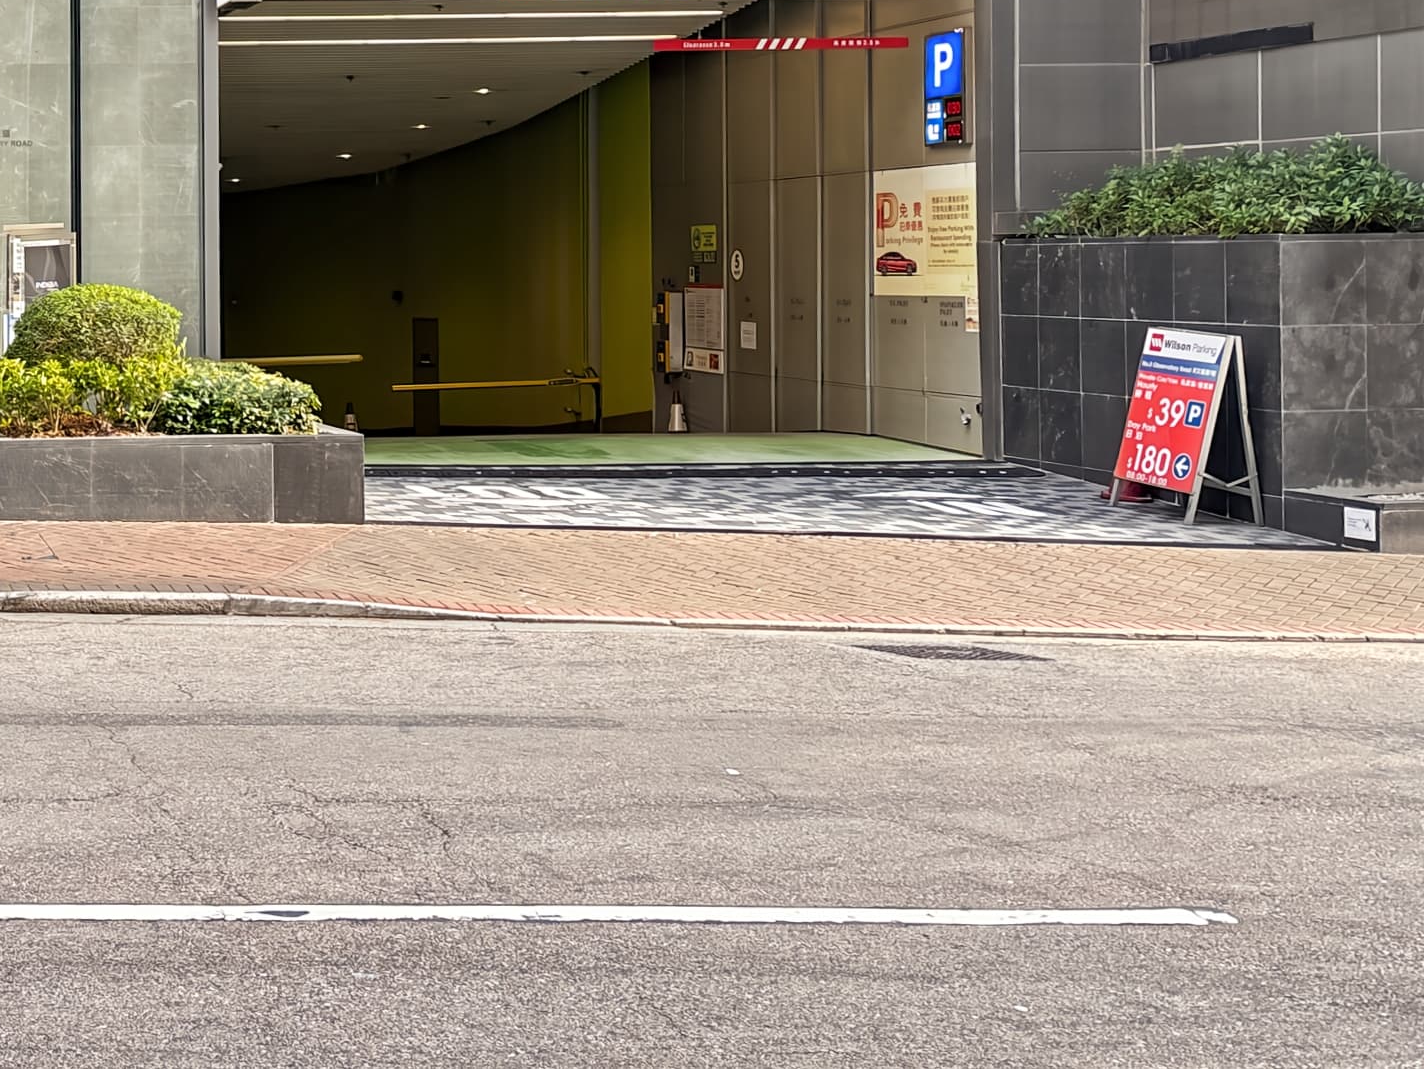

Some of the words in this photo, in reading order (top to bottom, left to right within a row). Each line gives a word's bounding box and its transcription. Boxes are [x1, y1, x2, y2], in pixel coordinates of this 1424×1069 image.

[934, 42, 954, 88] P
[10, 139, 33, 148] ROAD
[1164, 338, 1192, 352] Wilson
[1192, 342, 1218, 358] Parking
[1136, 380, 1158, 391] Hourly
[1127, 419, 1142, 431] Day
[1141, 422, 1157, 433] Park
